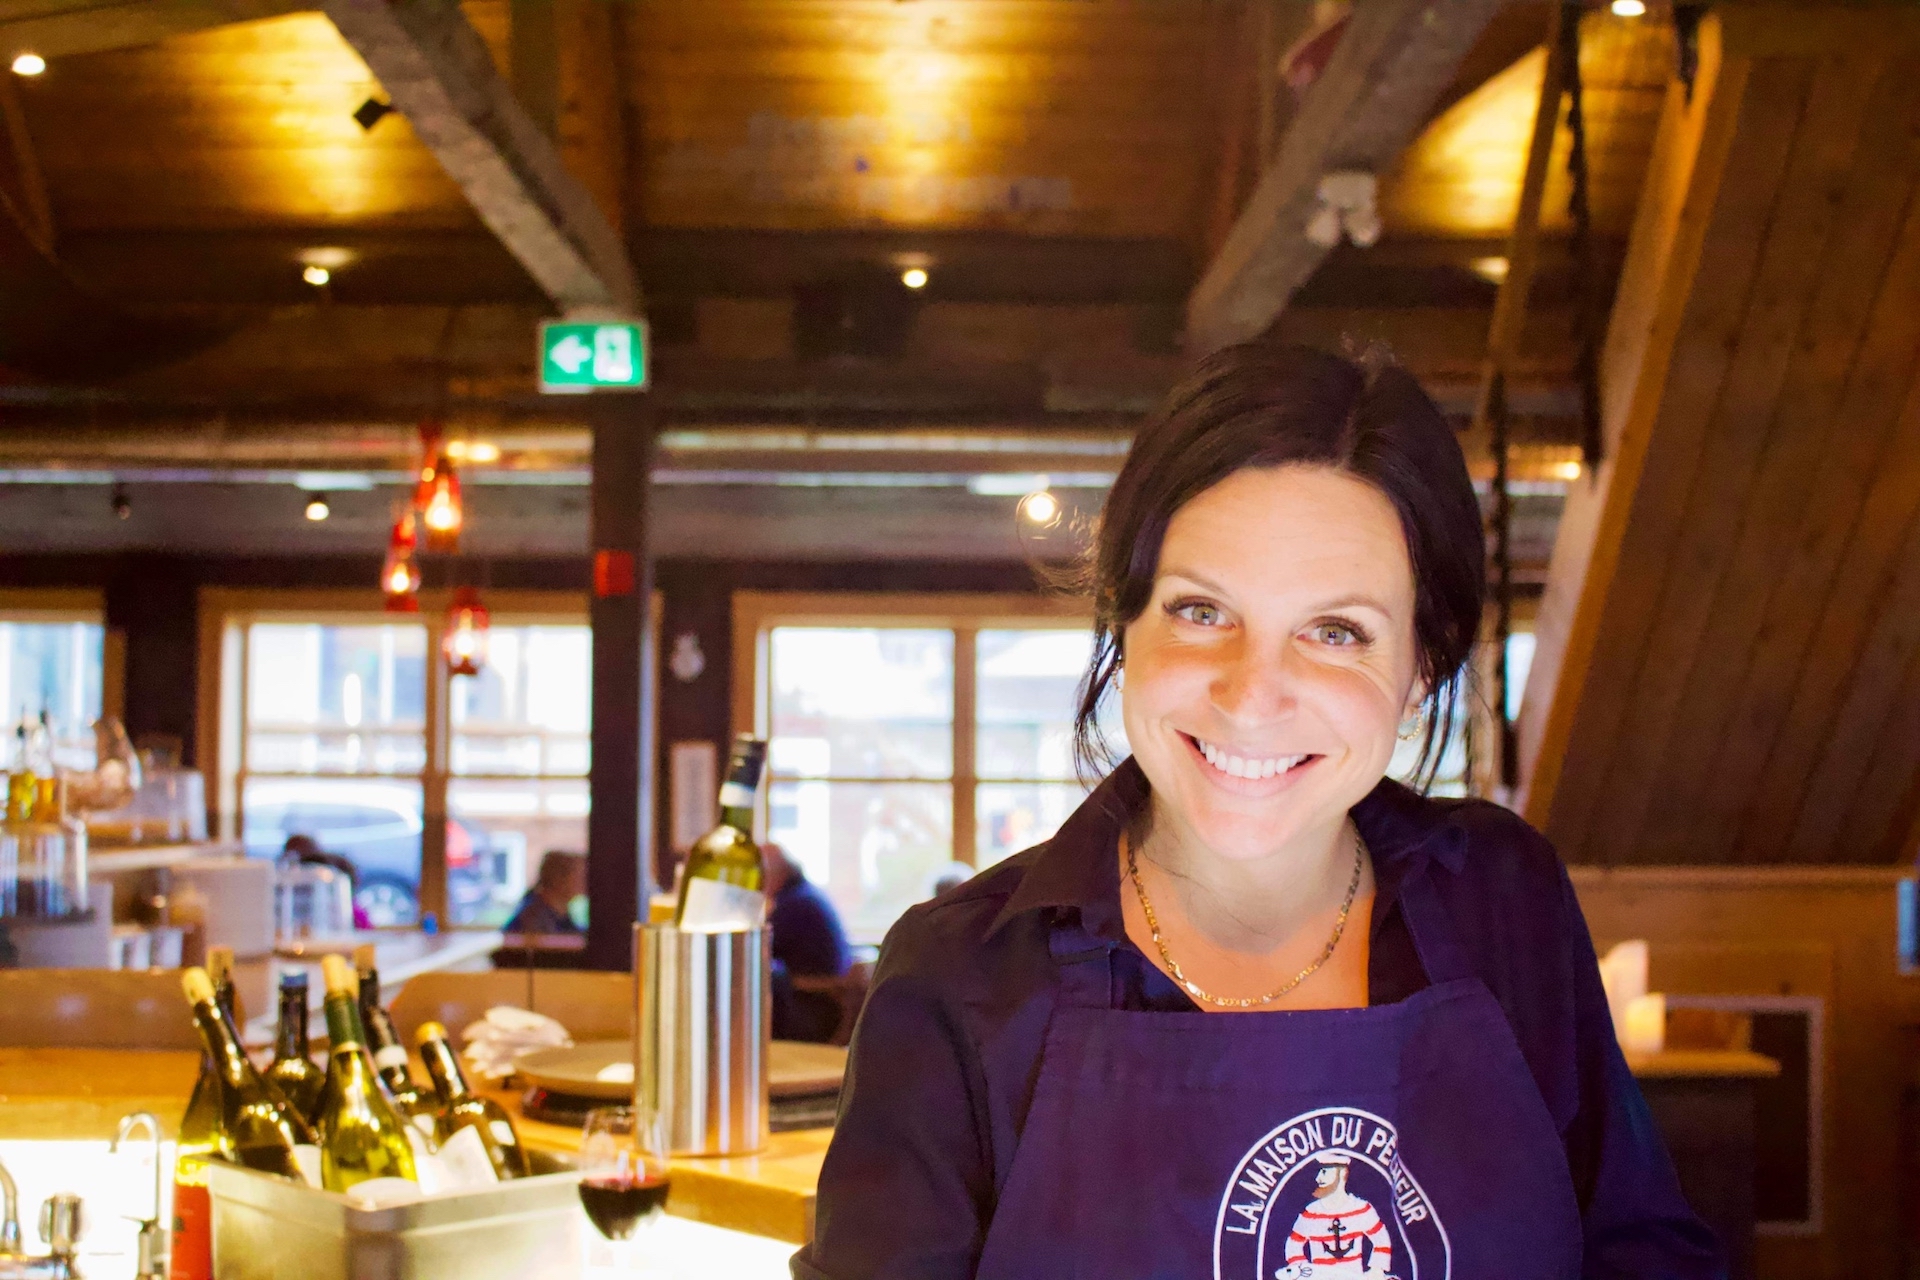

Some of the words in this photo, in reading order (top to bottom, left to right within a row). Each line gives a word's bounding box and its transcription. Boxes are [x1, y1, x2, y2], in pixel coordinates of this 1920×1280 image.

[1331, 1117, 1363, 1148] DU
[1239, 1119, 1325, 1200] MAISON
[1226, 1200, 1265, 1235] LA
